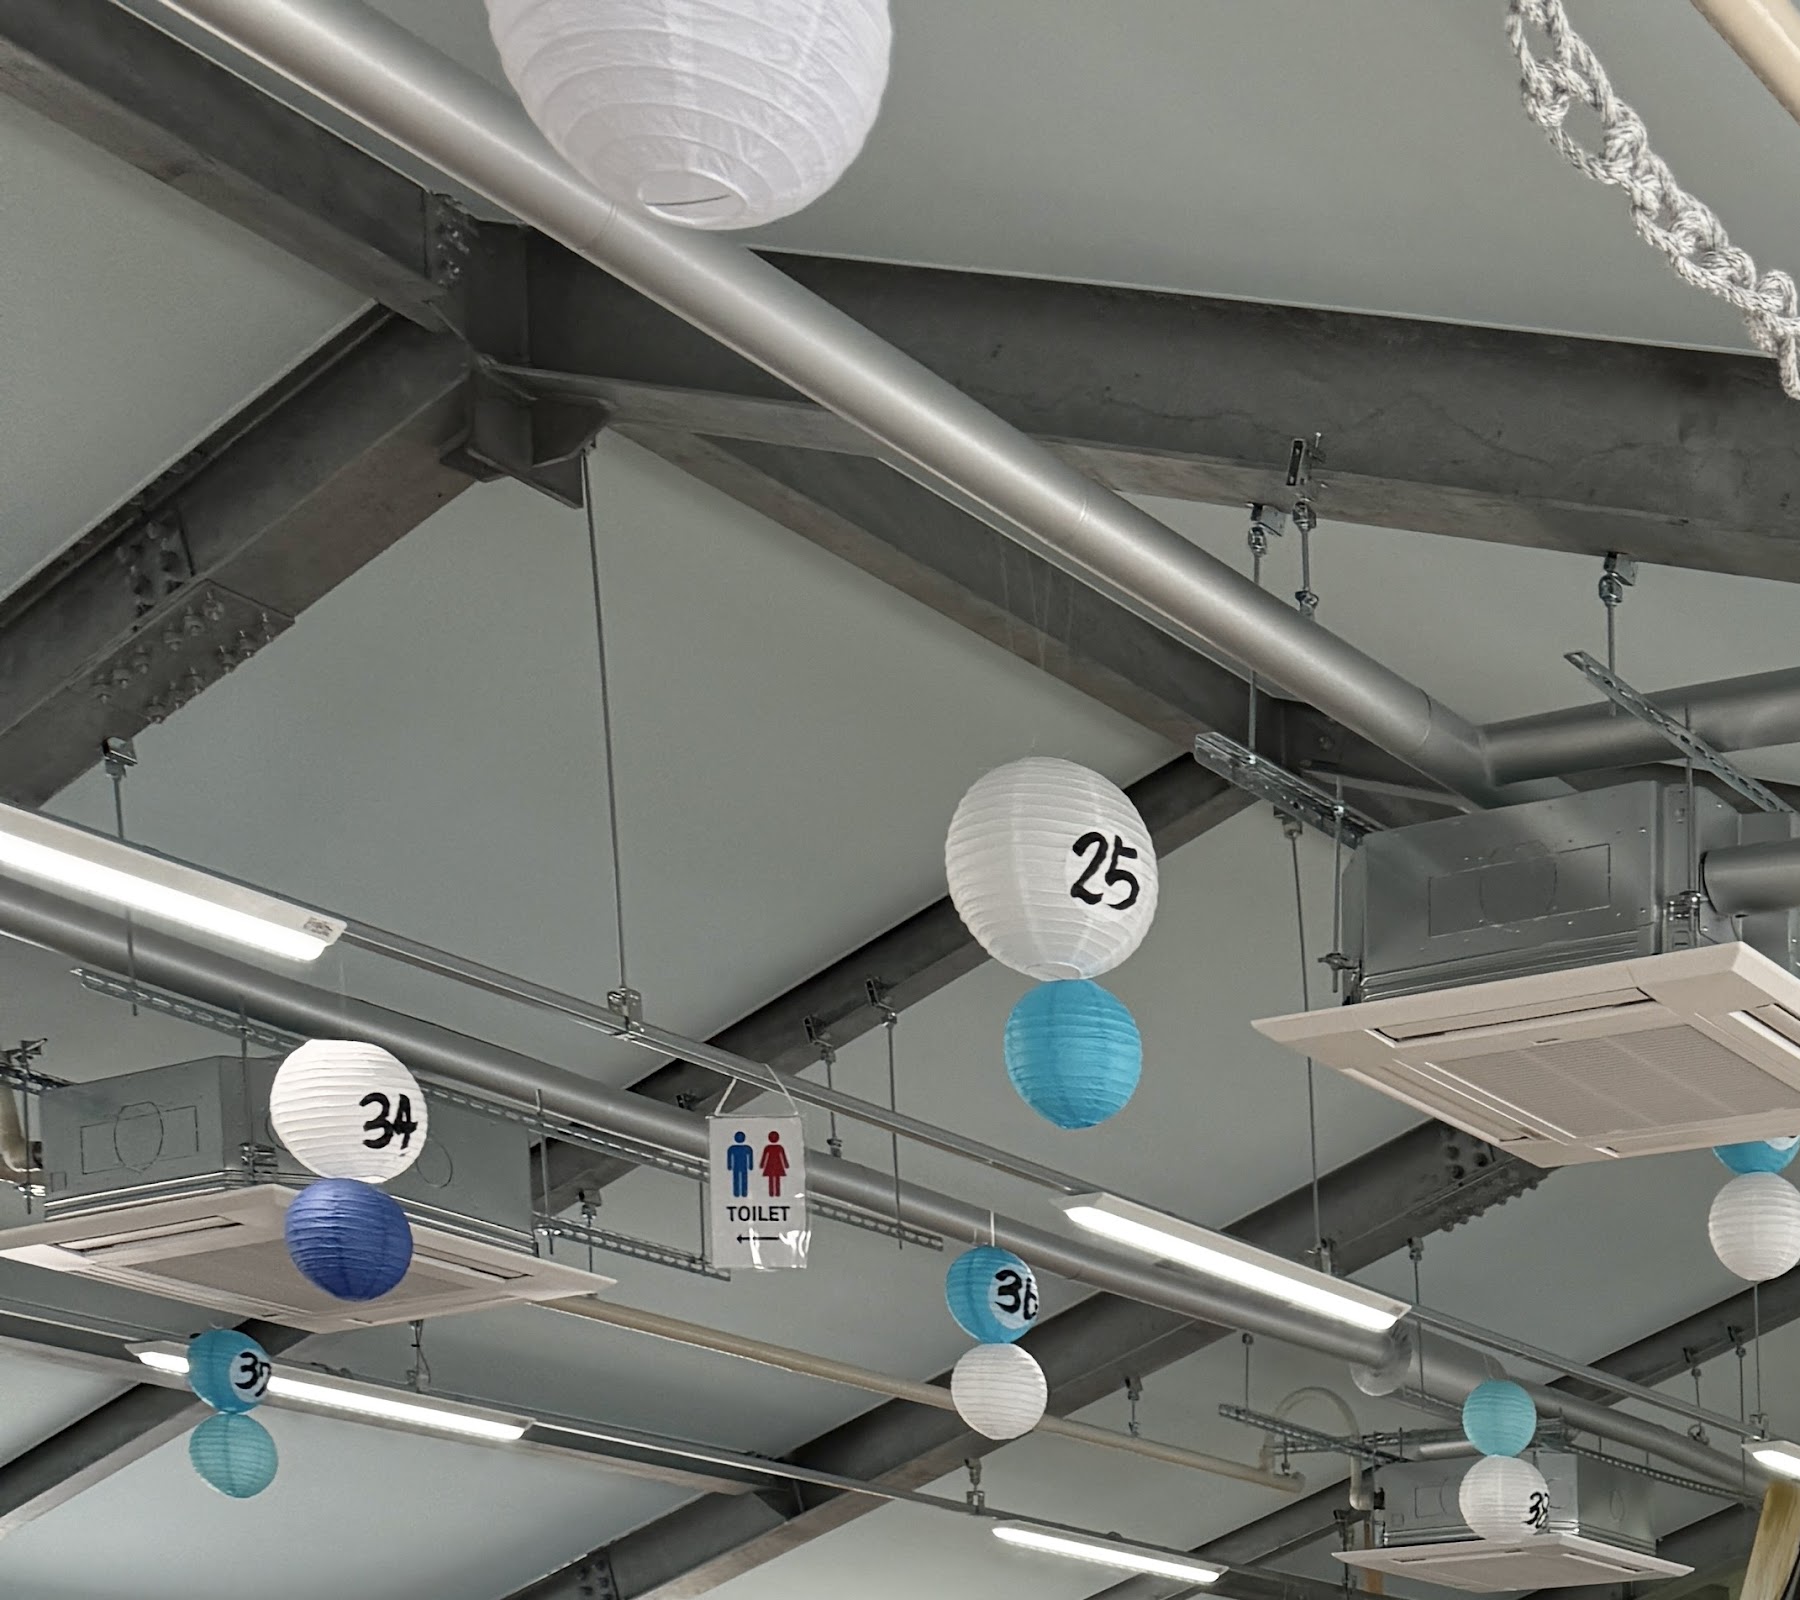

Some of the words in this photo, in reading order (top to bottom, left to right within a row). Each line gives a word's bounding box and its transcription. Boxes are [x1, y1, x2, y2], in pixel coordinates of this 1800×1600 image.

[1070, 831, 1140, 911] 25
[358, 1091, 419, 1151] 34
[726, 1205, 791, 1224] TOILET
